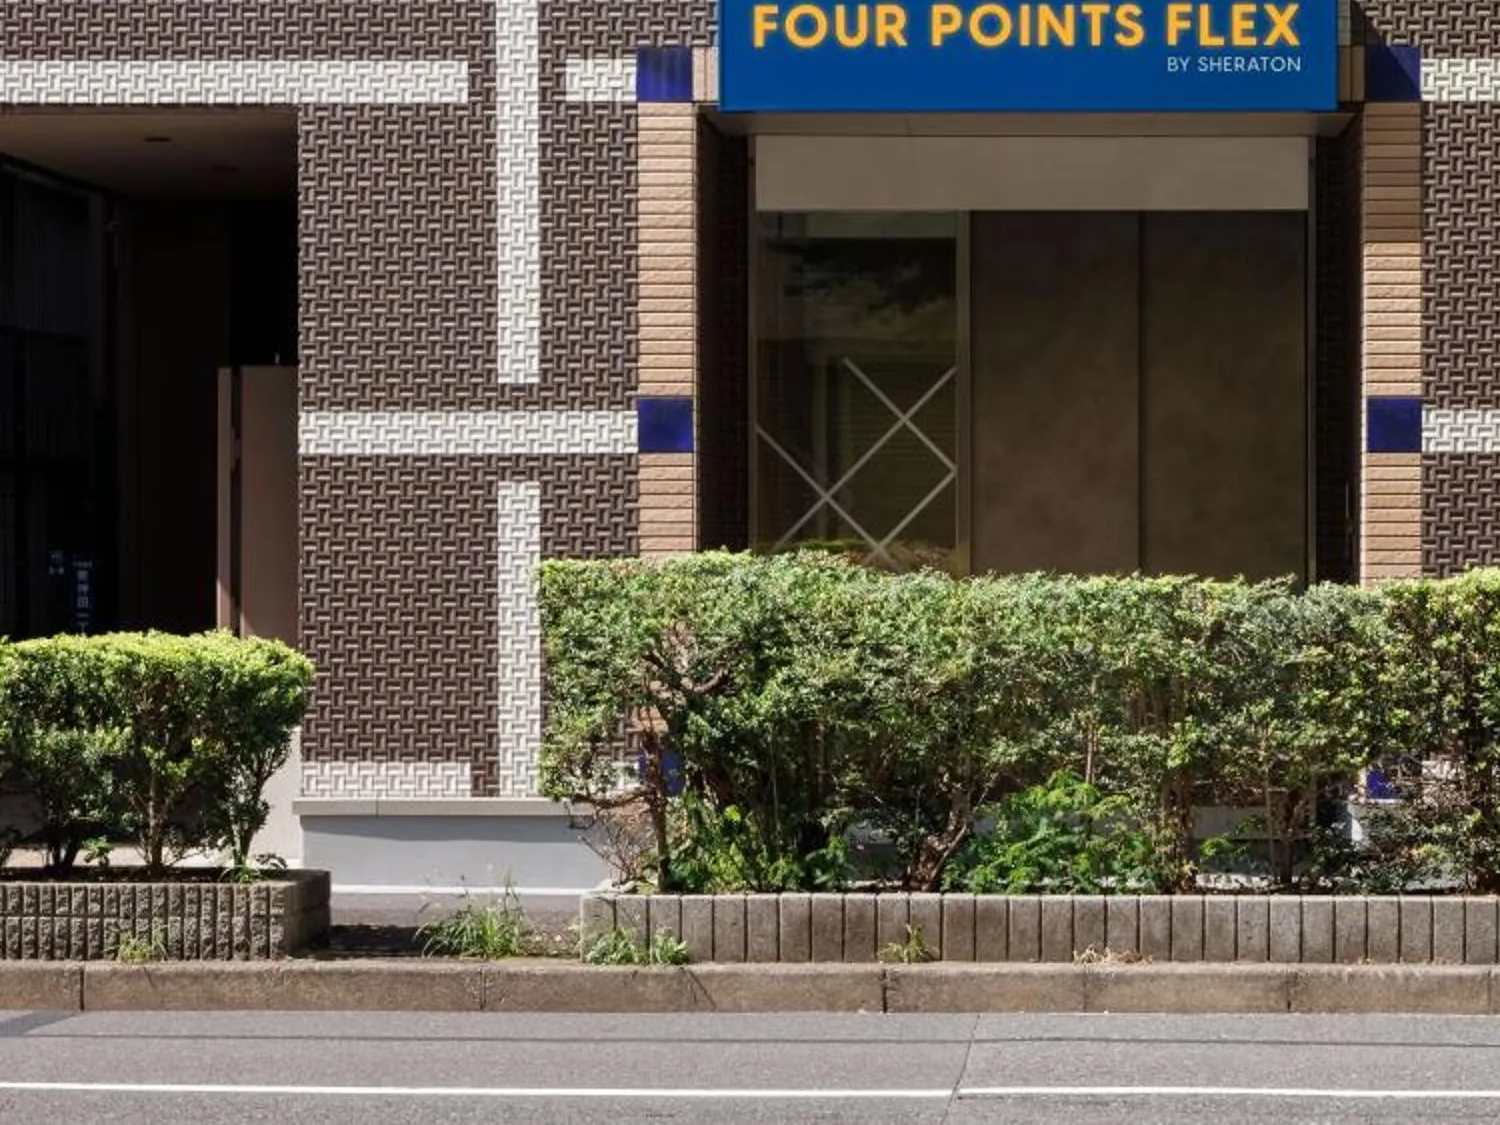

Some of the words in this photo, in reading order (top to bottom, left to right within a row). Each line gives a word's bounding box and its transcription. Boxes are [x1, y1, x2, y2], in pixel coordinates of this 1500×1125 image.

[752, 2, 908, 49] FOUR
[930, 2, 1145, 49] POINTS
[1165, 2, 1301, 48] FLEX
[1167, 56, 1191, 73] BY
[1197, 56, 1301, 73] SHERATON
